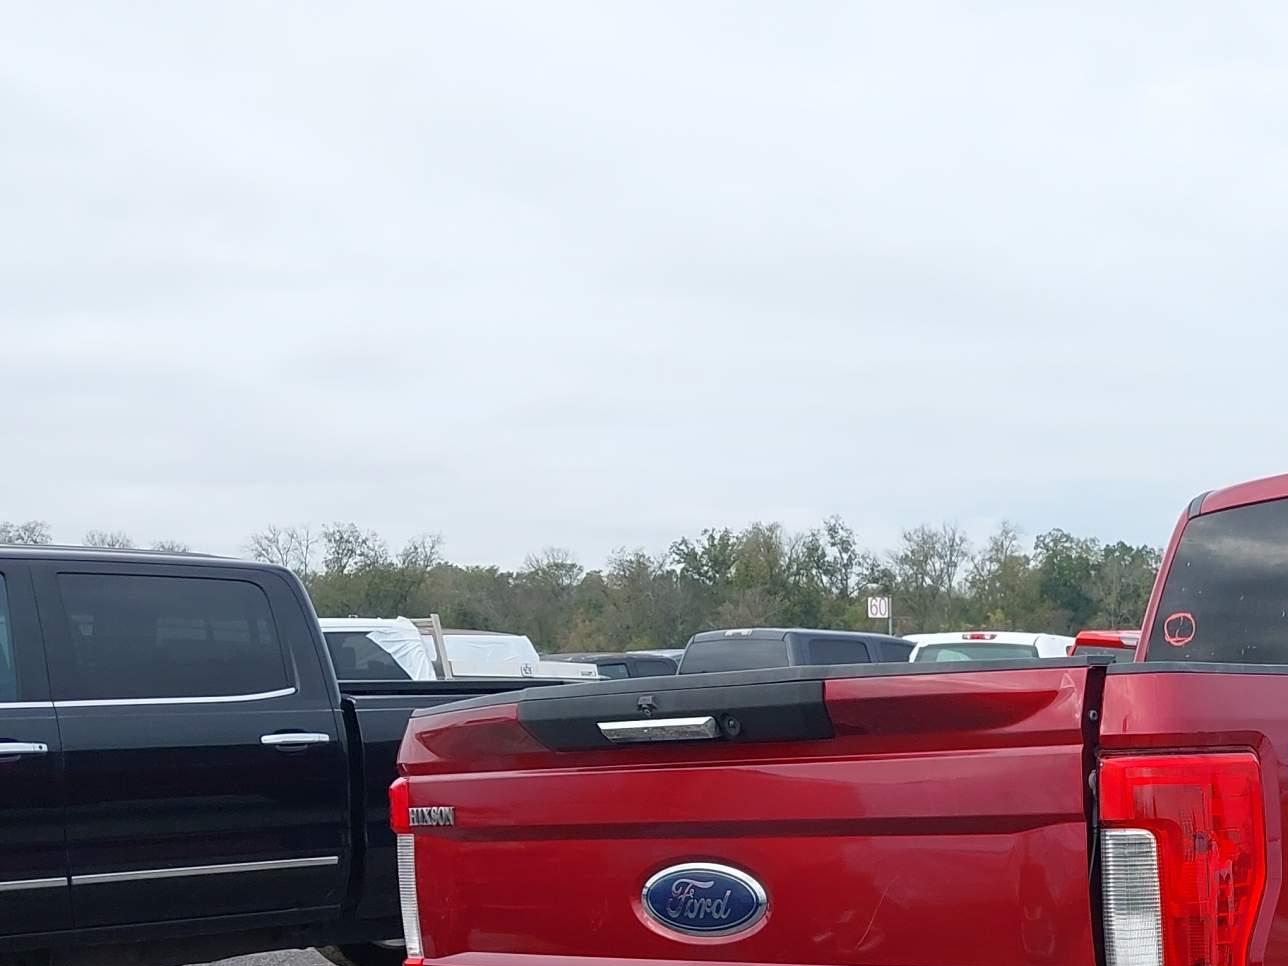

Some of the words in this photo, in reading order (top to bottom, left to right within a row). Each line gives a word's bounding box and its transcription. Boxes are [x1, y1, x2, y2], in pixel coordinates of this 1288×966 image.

[870, 596, 888, 617] 60
[408, 806, 455, 826] HIXSON
[667, 878, 732, 919] Ford
